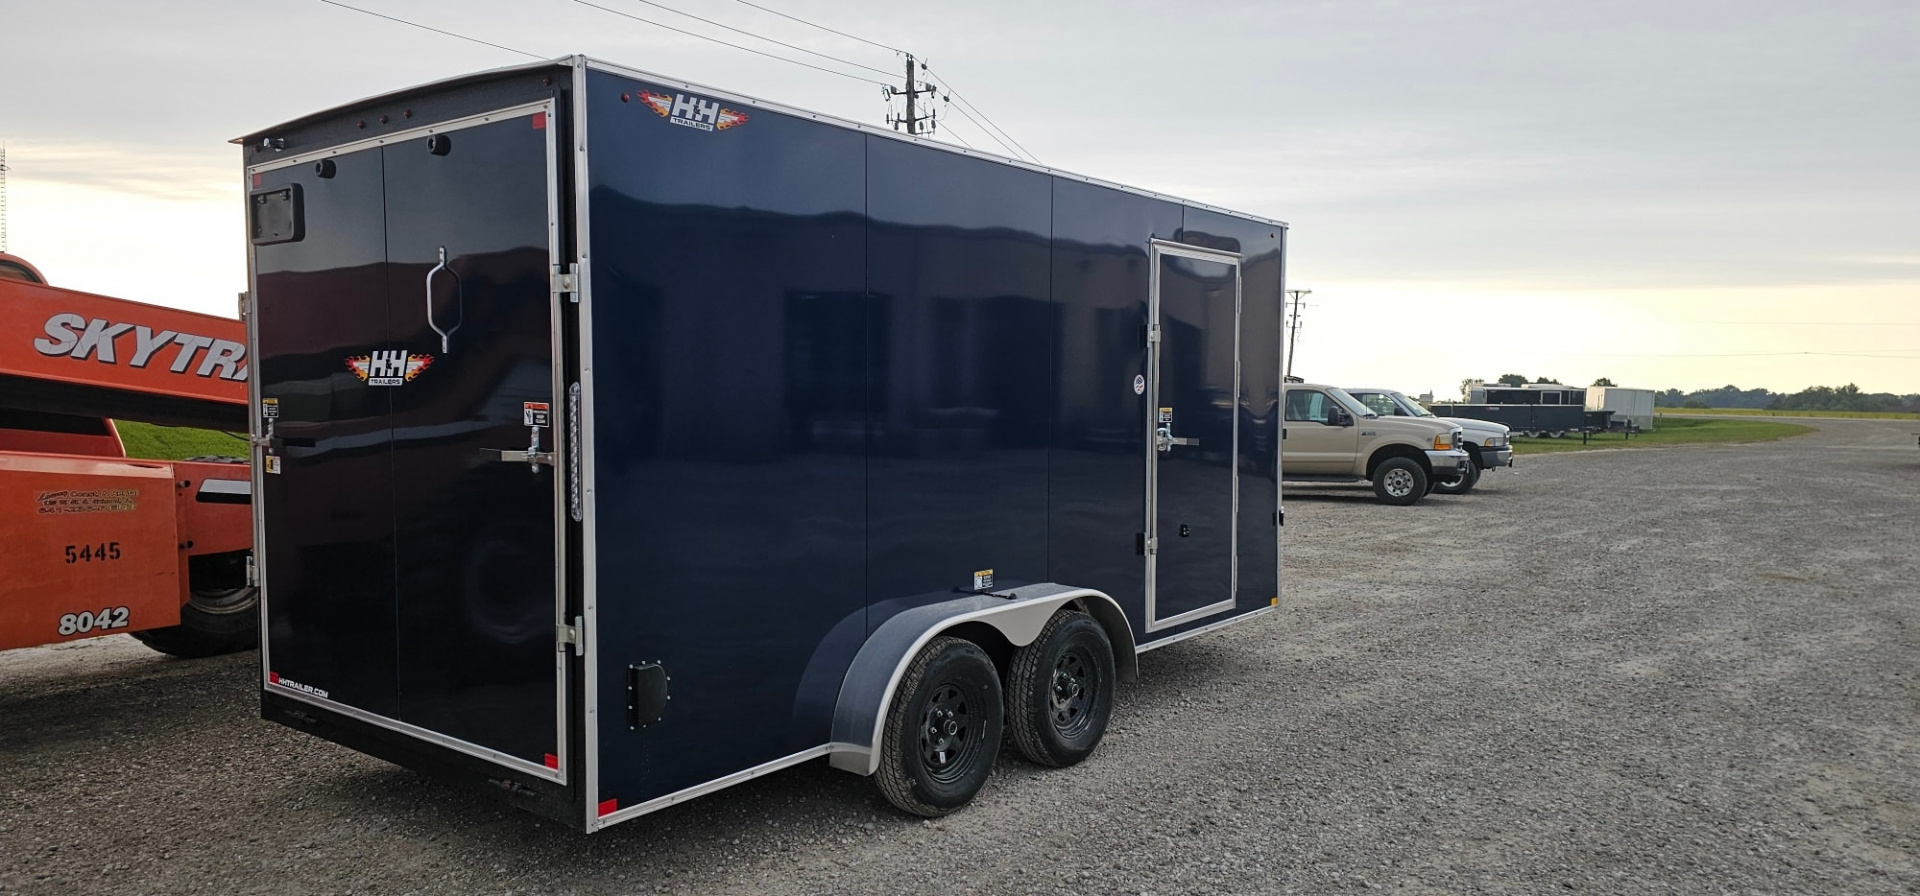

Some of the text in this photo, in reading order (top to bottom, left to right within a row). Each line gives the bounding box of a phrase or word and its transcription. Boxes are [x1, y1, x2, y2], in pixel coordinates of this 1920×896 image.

[672, 93, 719, 124] H&H
[671, 117, 713, 131] TRAILERS
[370, 350, 408, 377] H&H
[65, 542, 121, 564] 5445
[57, 606, 130, 636] 8042
[278, 677, 329, 698] HHTRAILER.COM
